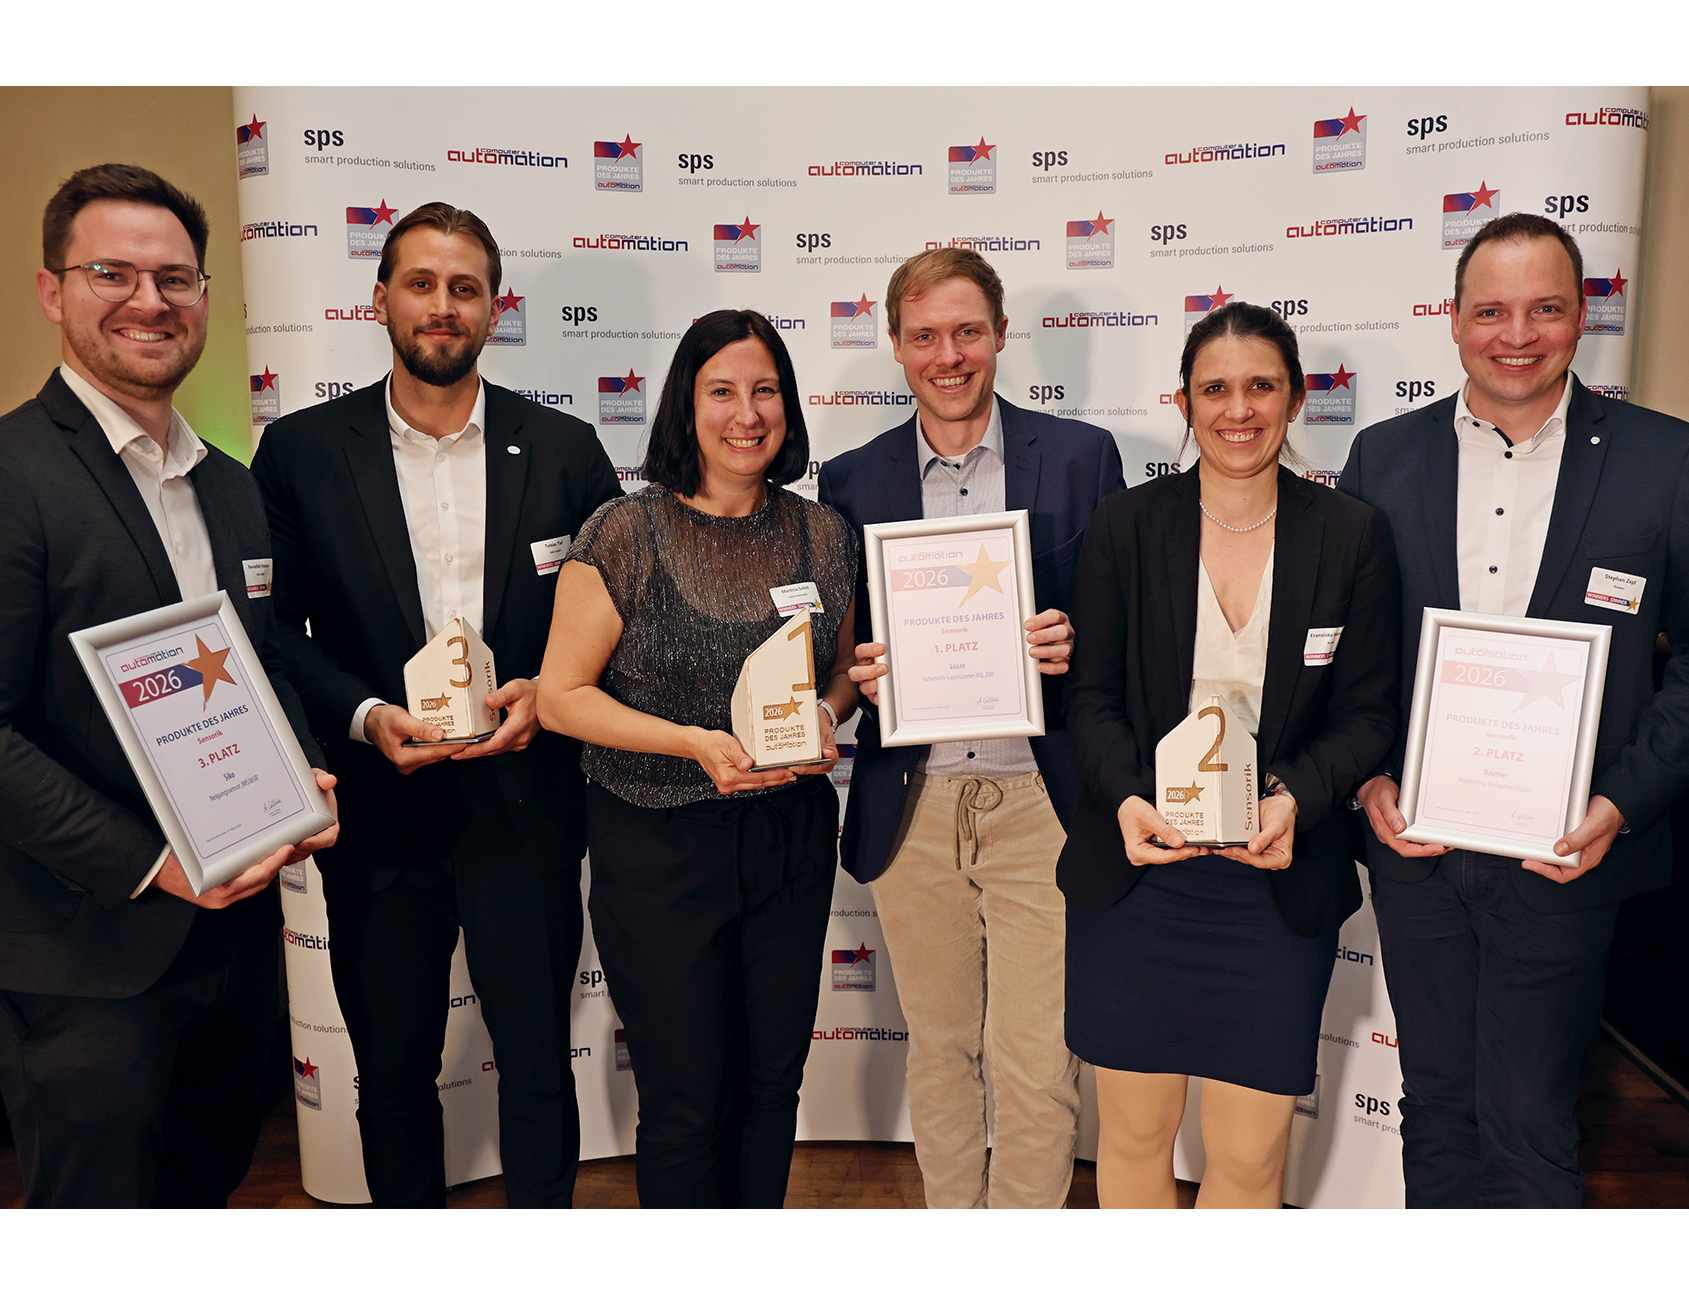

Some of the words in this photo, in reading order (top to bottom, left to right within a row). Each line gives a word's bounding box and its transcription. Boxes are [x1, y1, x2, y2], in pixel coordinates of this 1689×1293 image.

[1407, 115, 1448, 140] sps
[1566, 108, 1648, 132] automat
[304, 129, 344, 151] sps
[1316, 142, 1362, 153] PRODUKTE
[1406, 144, 1435, 155] smart
[1438, 136, 1495, 152] production
[1498, 131, 1550, 144] solutions
[448, 148, 568, 168] automation
[1032, 150, 1068, 171] sps
[1165, 143, 1285, 164] automation
[1316, 151, 1331, 160] DES
[1332, 149, 1362, 158] JAHRES
[305, 156, 333, 164] smart
[337, 156, 390, 167] production
[393, 160, 436, 172] solutions
[597, 165, 639, 173] PRODUKTE
[678, 153, 714, 173] sps
[808, 161, 922, 176] automation
[679, 177, 704, 185] smart
[707, 177, 754, 187] production
[757, 178, 797, 187] solutions
[1032, 175, 1058, 183] smart
[1061, 172, 1109, 184] production
[1112, 170, 1153, 180] solutions
[1544, 195, 1589, 218] sps
[240, 221, 317, 242] tomation
[1150, 224, 1187, 245] sps
[1287, 217, 1412, 238] automation
[1445, 228, 1460, 236] DES
[1579, 222, 1628, 234] production
[573, 234, 688, 251] automation
[796, 233, 831, 252] sps
[1150, 249, 1177, 258] smart
[1179, 245, 1229, 258] production
[1232, 243, 1274, 253] solutions
[520, 249, 562, 258] solutions
[796, 256, 822, 264] smart
[824, 255, 871, 265] production
[562, 306, 598, 326] sps
[1271, 299, 1308, 319] sps
[273, 323, 313, 333] solutions
[1043, 312, 1158, 328] automation
[1300, 322, 1352, 334] production
[1354, 321, 1399, 330] solutions
[562, 330, 588, 338] smart
[591, 330, 639, 340] production
[641, 330, 681, 339] solutions
[314, 382, 354, 400] sps
[1029, 384, 1065, 404] sps
[1395, 380, 1435, 402] sps
[1057, 407, 1105, 417] production
[1108, 407, 1148, 416] solutions
[1145, 462, 1181, 478] sps
[899, 551, 963, 562] automation
[903, 569, 949, 588] 2026
[904, 615, 950, 627] PRODUKTE
[953, 614, 970, 623] DES
[972, 612, 1004, 622] JAHRES
[934, 645, 943, 653] 1.
[946, 642, 978, 652] PLATZ
[1454, 647, 1528, 662] automation
[120, 647, 184, 672] automation
[447, 636, 472, 688] 3
[788, 621, 816, 692] 1
[1454, 664, 1506, 687] 2026
[132, 670, 182, 702] 2026
[765, 707, 783, 717] 2026
[156, 723, 203, 746] PRODUKTE
[202, 716, 219, 729] DES
[220, 704, 249, 722] JAHRES
[764, 725, 804, 735] PRODUKTE
[1446, 713, 1499, 728] PRODUKTE
[1501, 720, 1520, 730] DES
[1522, 723, 1560, 736] JAHRES
[197, 730, 223, 744] Sensorik
[765, 734, 778, 742] DES
[780, 732, 806, 740] JAHRES
[1198, 706, 1228, 772] 2
[1486, 731, 1516, 741] Sensorik
[198, 758, 209, 768] 3.
[209, 743, 240, 764] PLATZ
[1473, 746, 1483, 756] 2.
[1486, 748, 1524, 762] PLATZ
[1484, 769, 1508, 778] Baumer
[1167, 790, 1184, 800] 2026
[1244, 763, 1252, 831] Sensorik
[581, 991, 605, 999] smart
[1355, 1093, 1390, 1115] sps
[1354, 1115, 1380, 1128] smart
